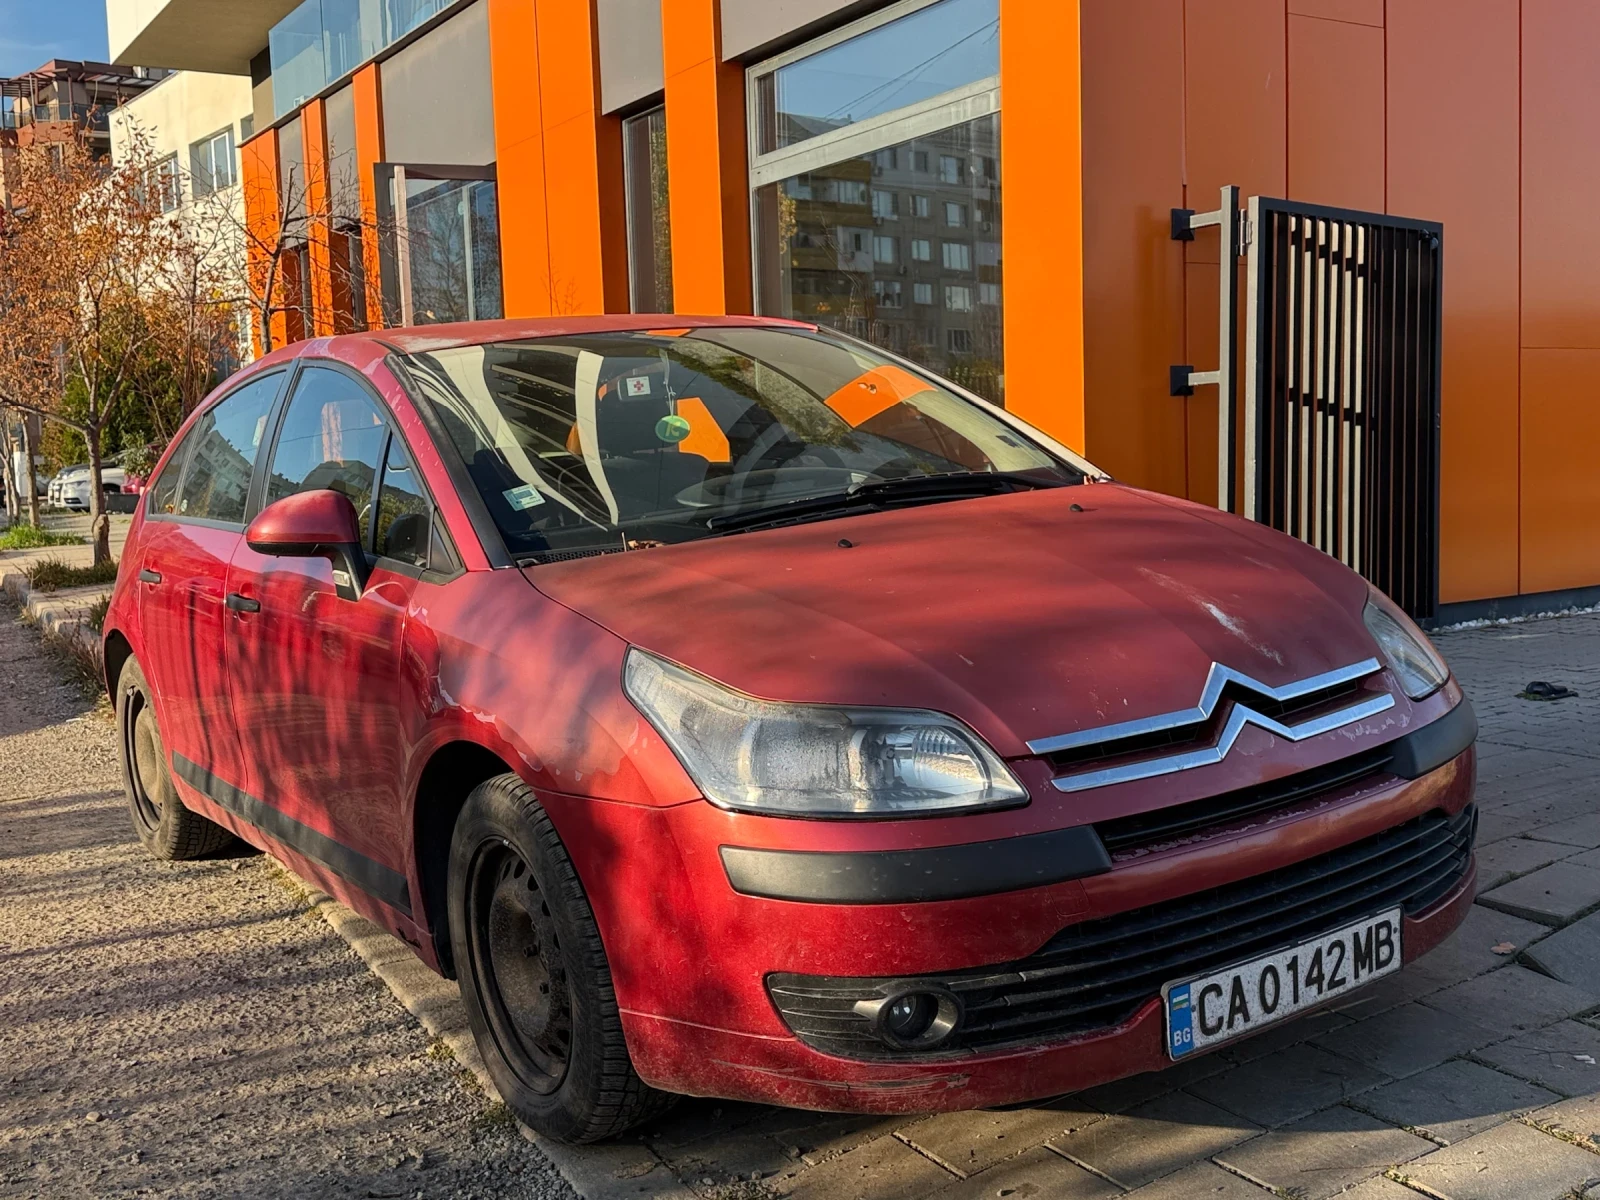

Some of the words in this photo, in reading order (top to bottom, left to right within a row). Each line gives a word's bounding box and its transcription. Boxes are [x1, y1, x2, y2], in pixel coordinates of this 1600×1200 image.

[1199, 975, 1250, 1036] CA
[1259, 939, 1347, 1014] 0142
[1353, 919, 1395, 980] MB
[1174, 1028, 1191, 1046] BG
